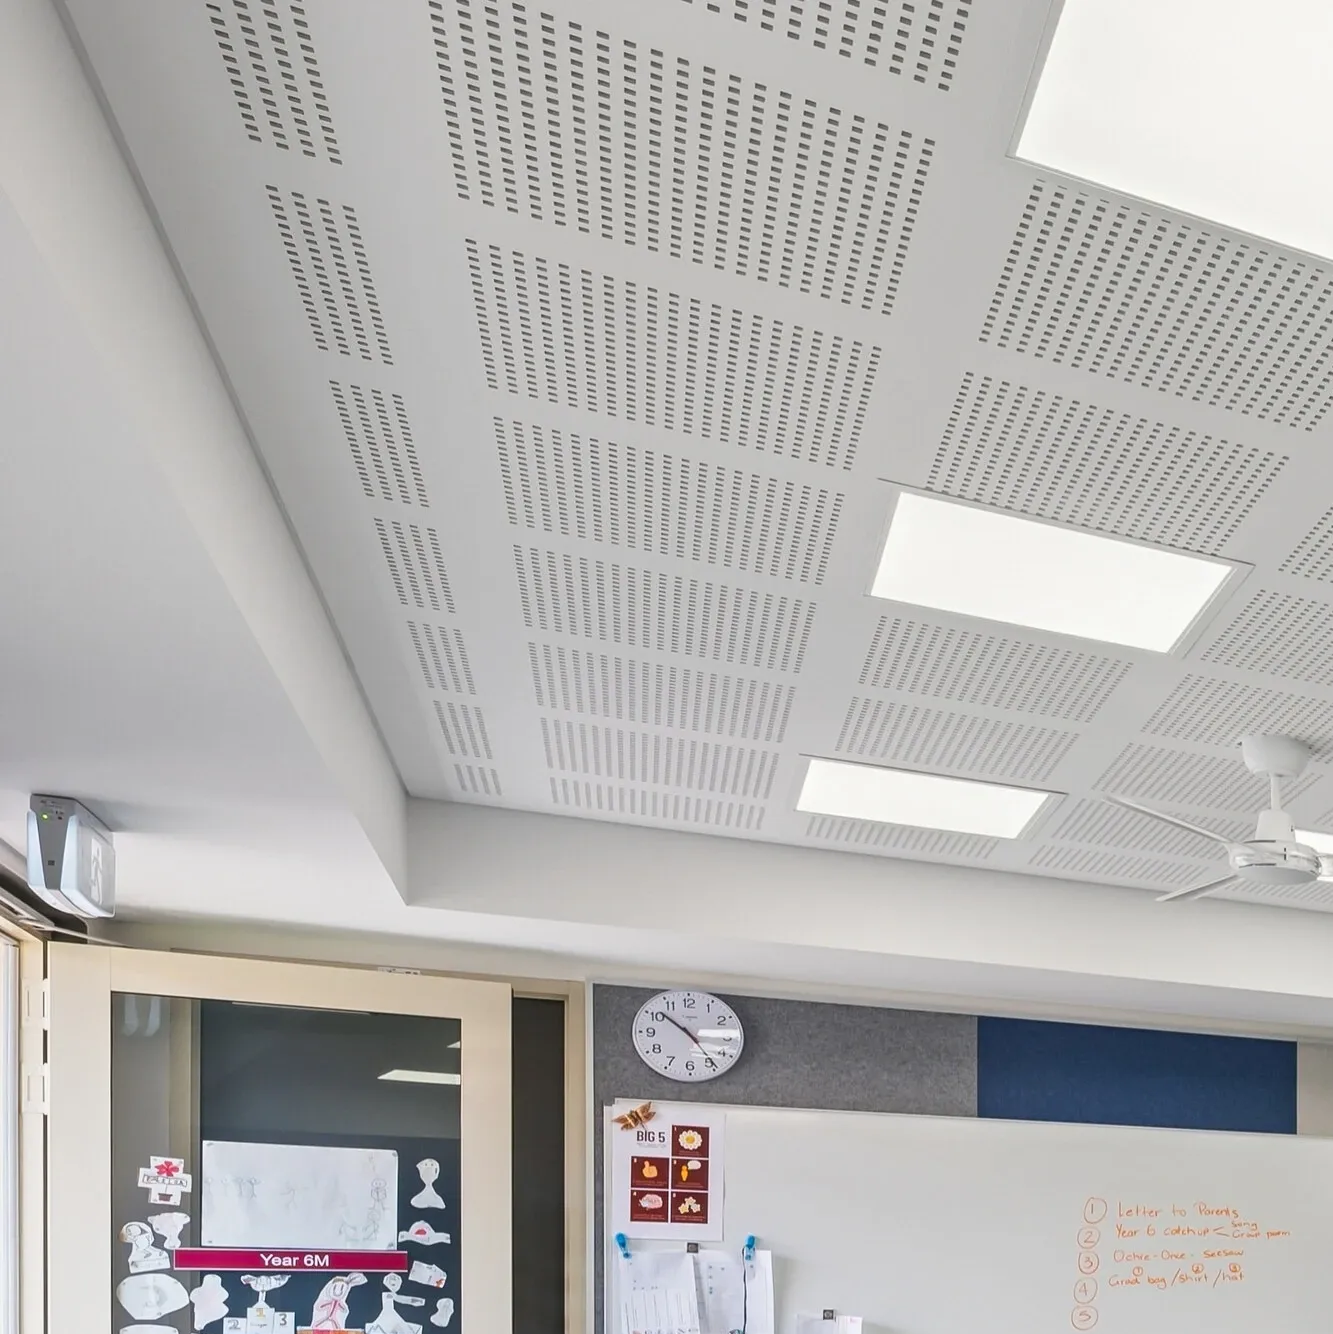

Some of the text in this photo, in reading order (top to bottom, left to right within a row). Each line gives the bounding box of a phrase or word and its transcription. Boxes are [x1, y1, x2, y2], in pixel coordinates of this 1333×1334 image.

[666, 1001, 675, 1011] 11
[683, 998, 696, 1009] 12
[706, 1003, 711, 1013] 1
[651, 1011, 665, 1022] 10
[717, 1015, 727, 1026] 2
[646, 1027, 656, 1038] 9
[652, 1044, 662, 1054] 8
[666, 1056, 676, 1066] 7
[685, 1060, 695, 1071] 6
[705, 1057, 715, 1068] 5
[636, 1130, 666, 1143] BIG 5
[1118, 1201, 1162, 1217] Letter
[1172, 1203, 1187, 1217] to
[1193, 1201, 1239, 1219] Parents
[1116, 1224, 1140, 1238] Year
[1147, 1224, 1156, 1236] 6
[260, 1254, 329, 1267] Year 6M
[1147, 1276, 1167, 1290] bag
[279, 1313, 288, 1326] 3
